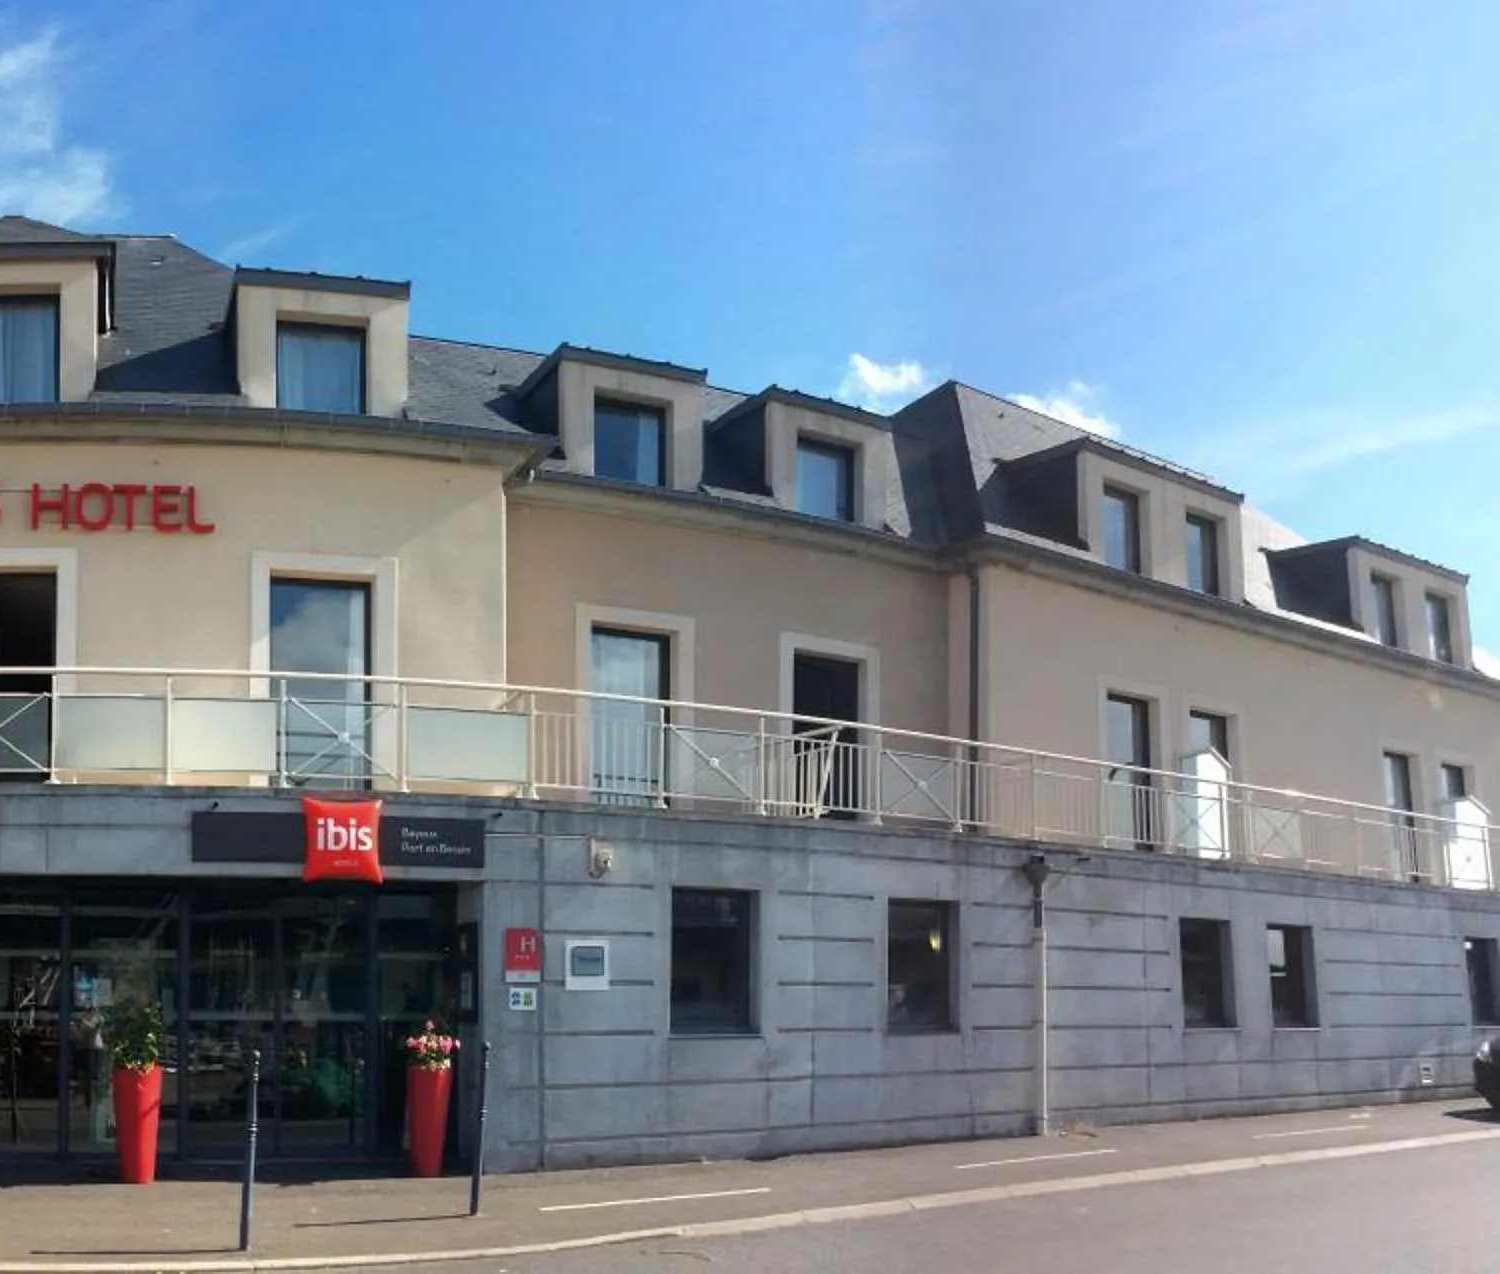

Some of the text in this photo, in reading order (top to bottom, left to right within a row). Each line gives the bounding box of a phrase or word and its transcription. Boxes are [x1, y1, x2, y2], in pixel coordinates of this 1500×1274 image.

[30, 483, 216, 535] HOTEL
[316, 817, 373, 851] ibis
[521, 936, 535, 953] H
